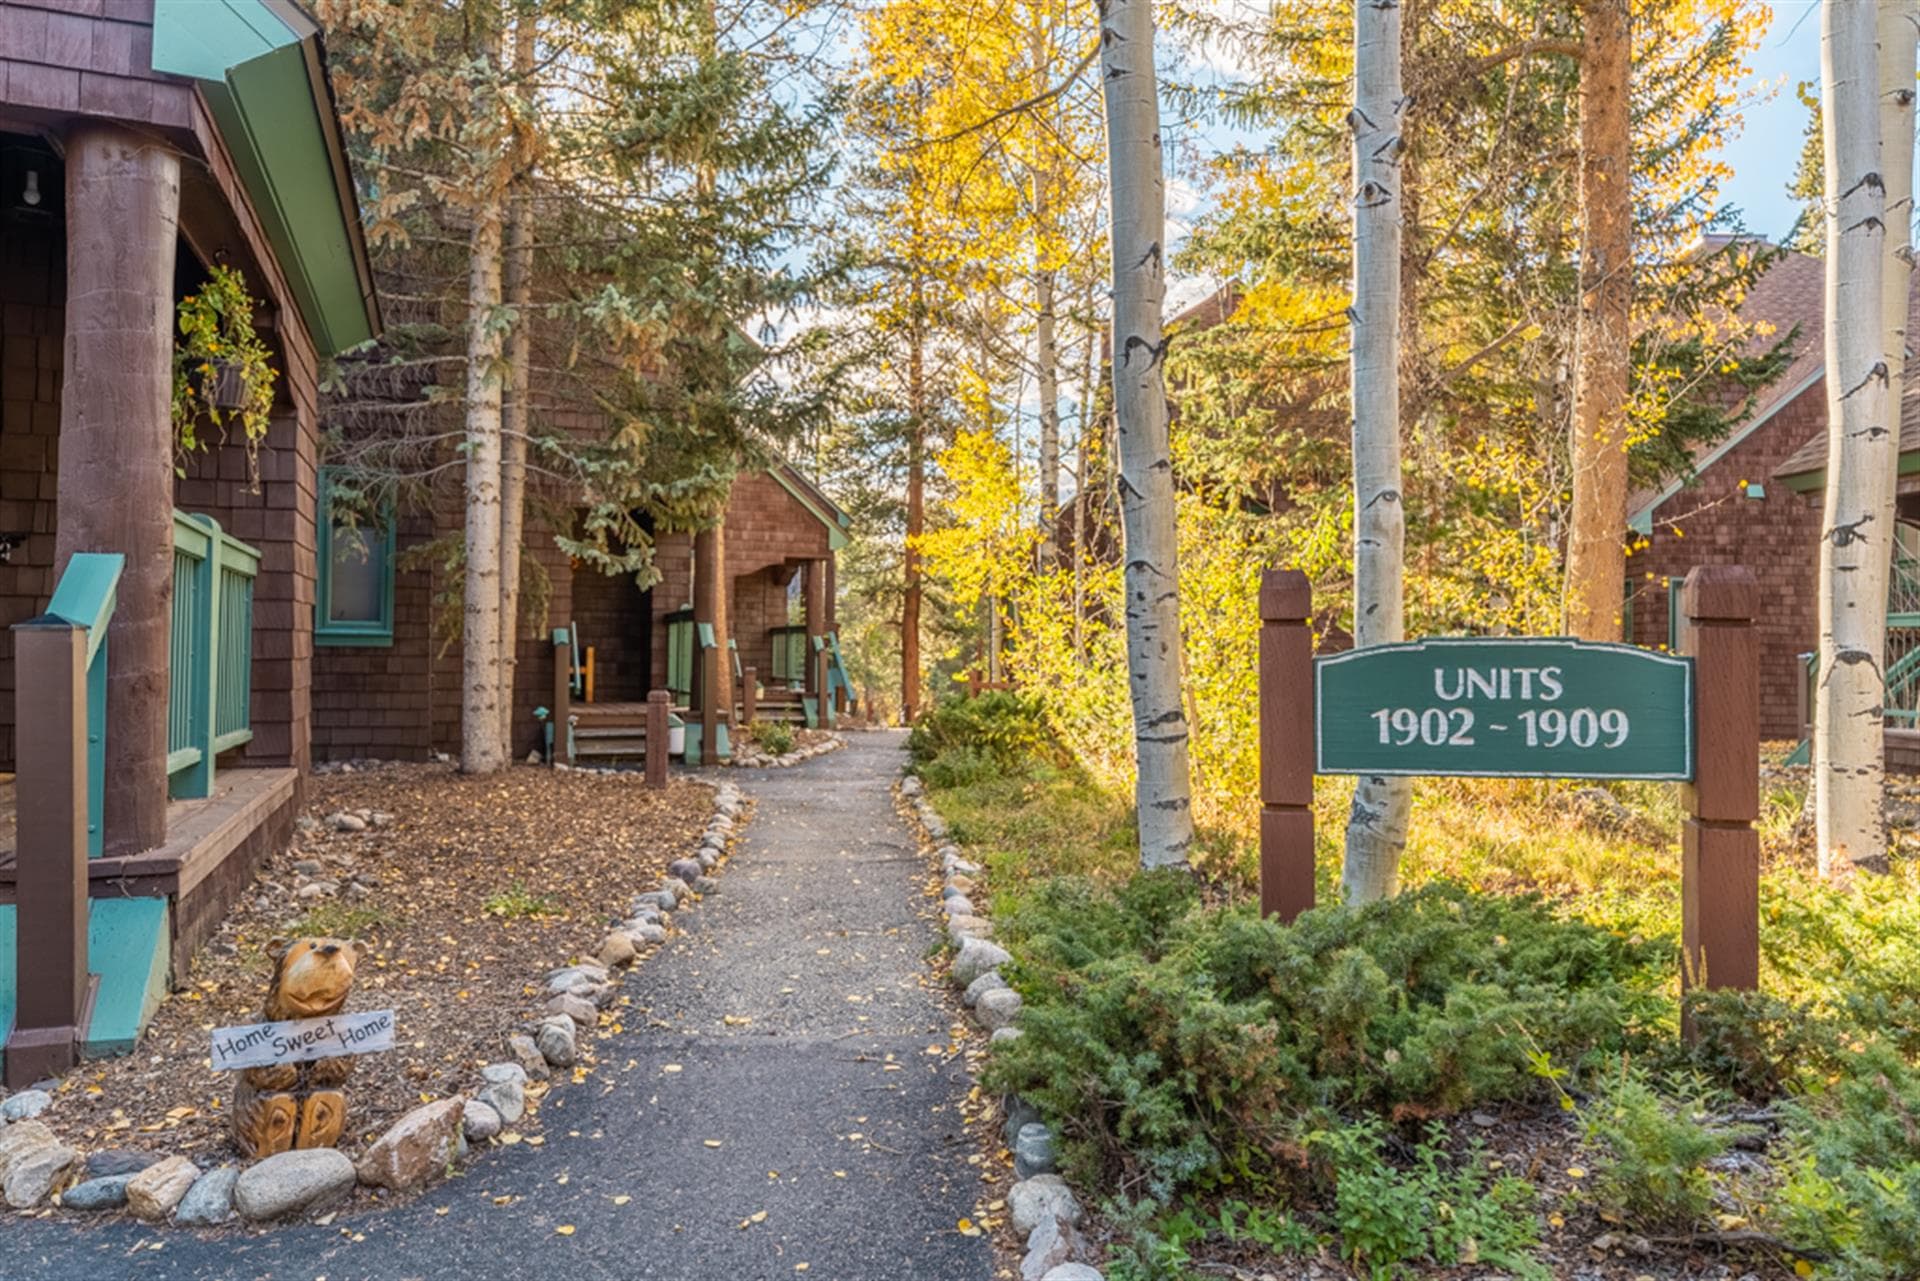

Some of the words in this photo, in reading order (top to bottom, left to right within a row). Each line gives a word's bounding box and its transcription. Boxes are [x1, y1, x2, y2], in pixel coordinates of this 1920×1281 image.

[1434, 667, 1563, 700] UNITS
[1371, 707, 1475, 746] 1902
[1518, 708, 1629, 748] 1909
[216, 1025, 276, 1060] Home
[272, 1019, 336, 1057] Sweet
[338, 1015, 391, 1048] Home
